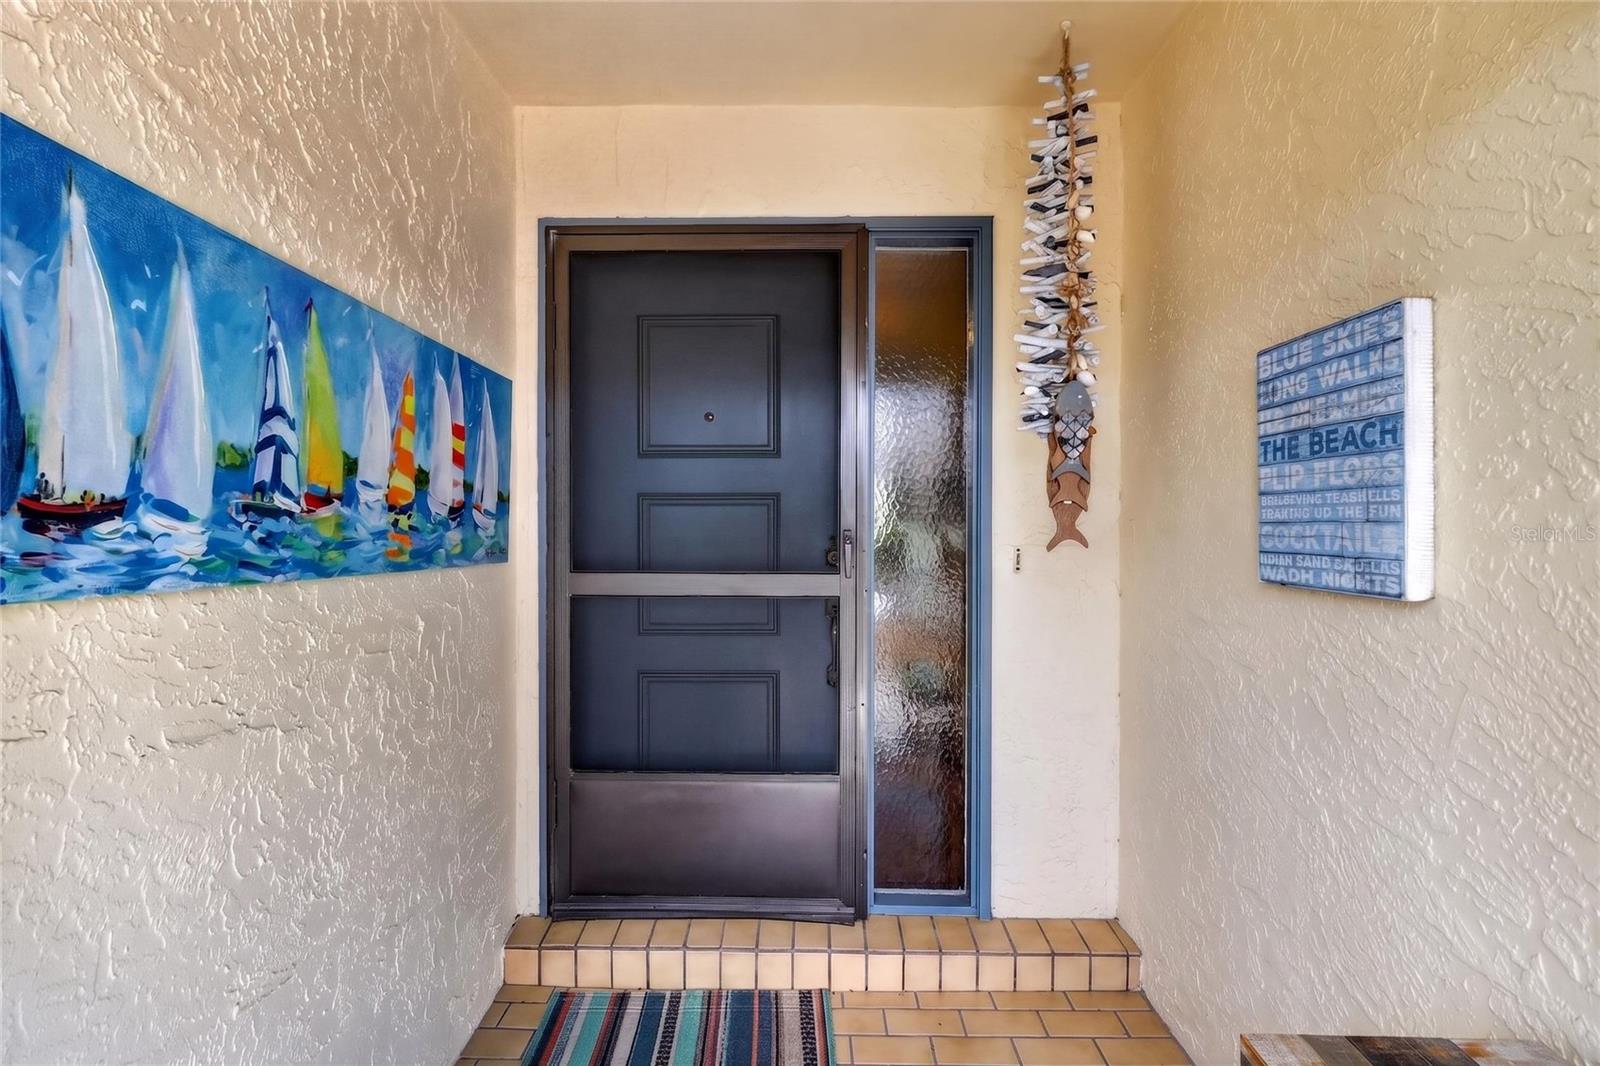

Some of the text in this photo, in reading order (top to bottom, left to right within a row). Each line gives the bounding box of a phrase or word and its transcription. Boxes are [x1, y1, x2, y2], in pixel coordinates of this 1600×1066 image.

[1260, 309, 1401, 378] BLUE SKIES
[1317, 344, 1400, 388] WALKS
[1260, 419, 1399, 462] THE BEACH
[1314, 452, 1400, 487] FLOPS
[1336, 505, 1364, 519] THE
[1261, 523, 1401, 554] COCKTAILS
